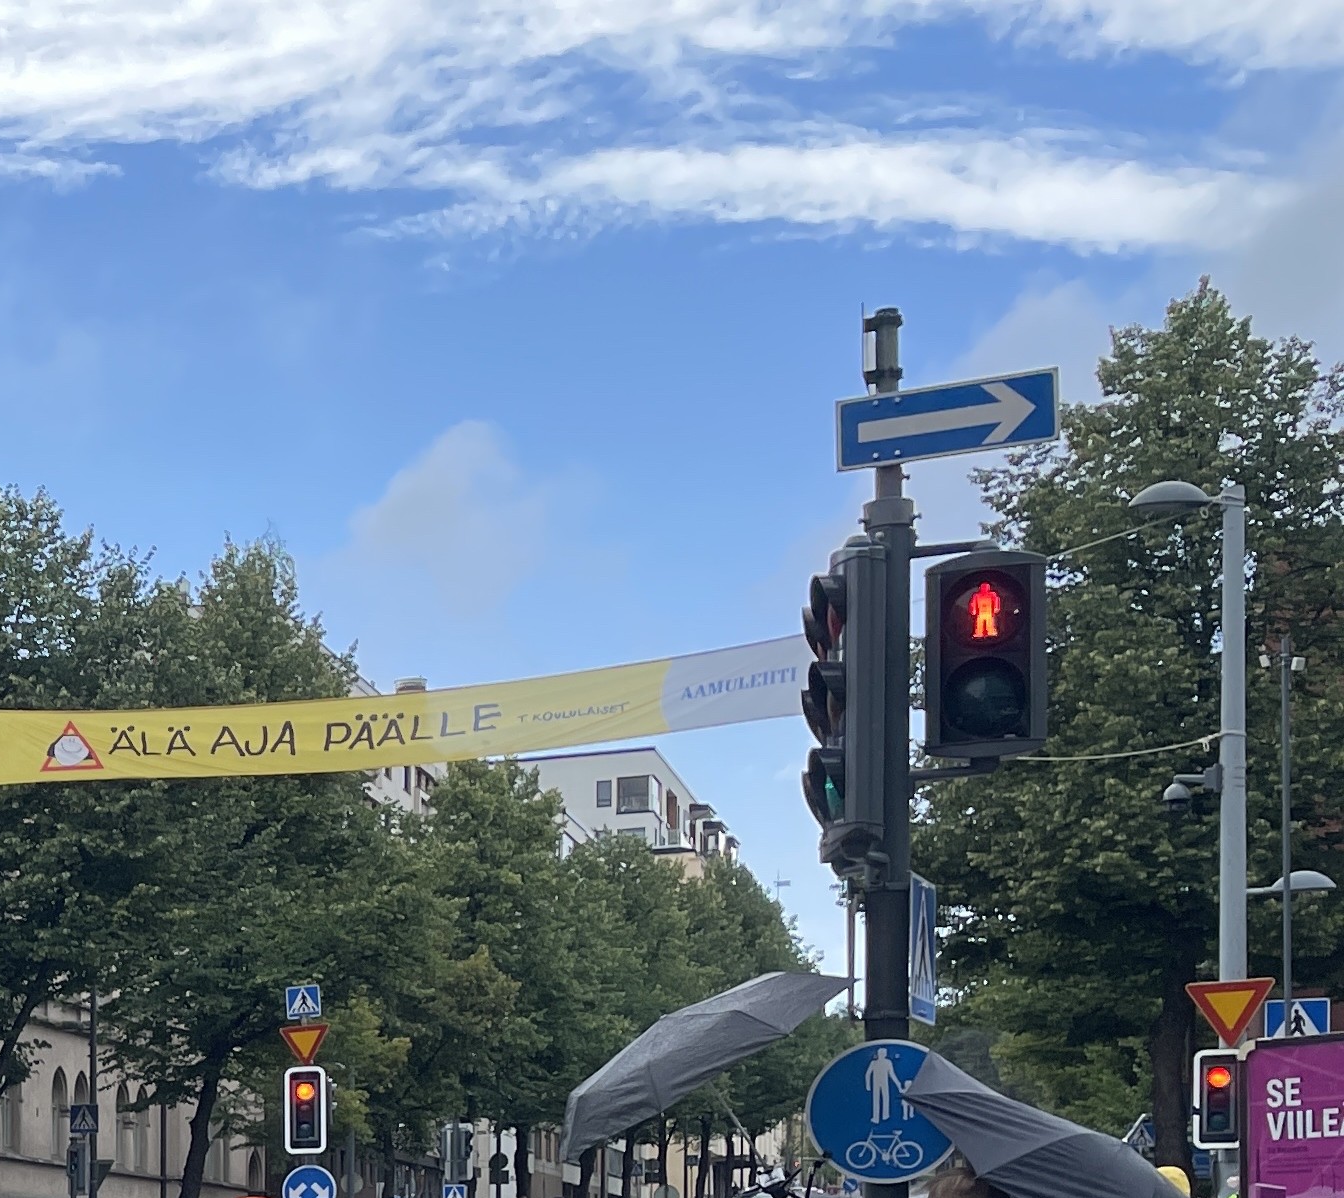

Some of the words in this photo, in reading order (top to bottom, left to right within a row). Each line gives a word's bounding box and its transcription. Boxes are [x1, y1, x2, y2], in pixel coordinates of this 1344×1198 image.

[681, 666, 798, 701] AAMULEHTI
[109, 725, 196, 756] ÄLÄ
[211, 721, 296, 757] AJA
[324, 703, 502, 751] PÄÄLLE
[532, 702, 630, 722] KOULULAISET
[1266, 1077, 1302, 1108] SE
[1267, 1103, 1344, 1141] VIILE
